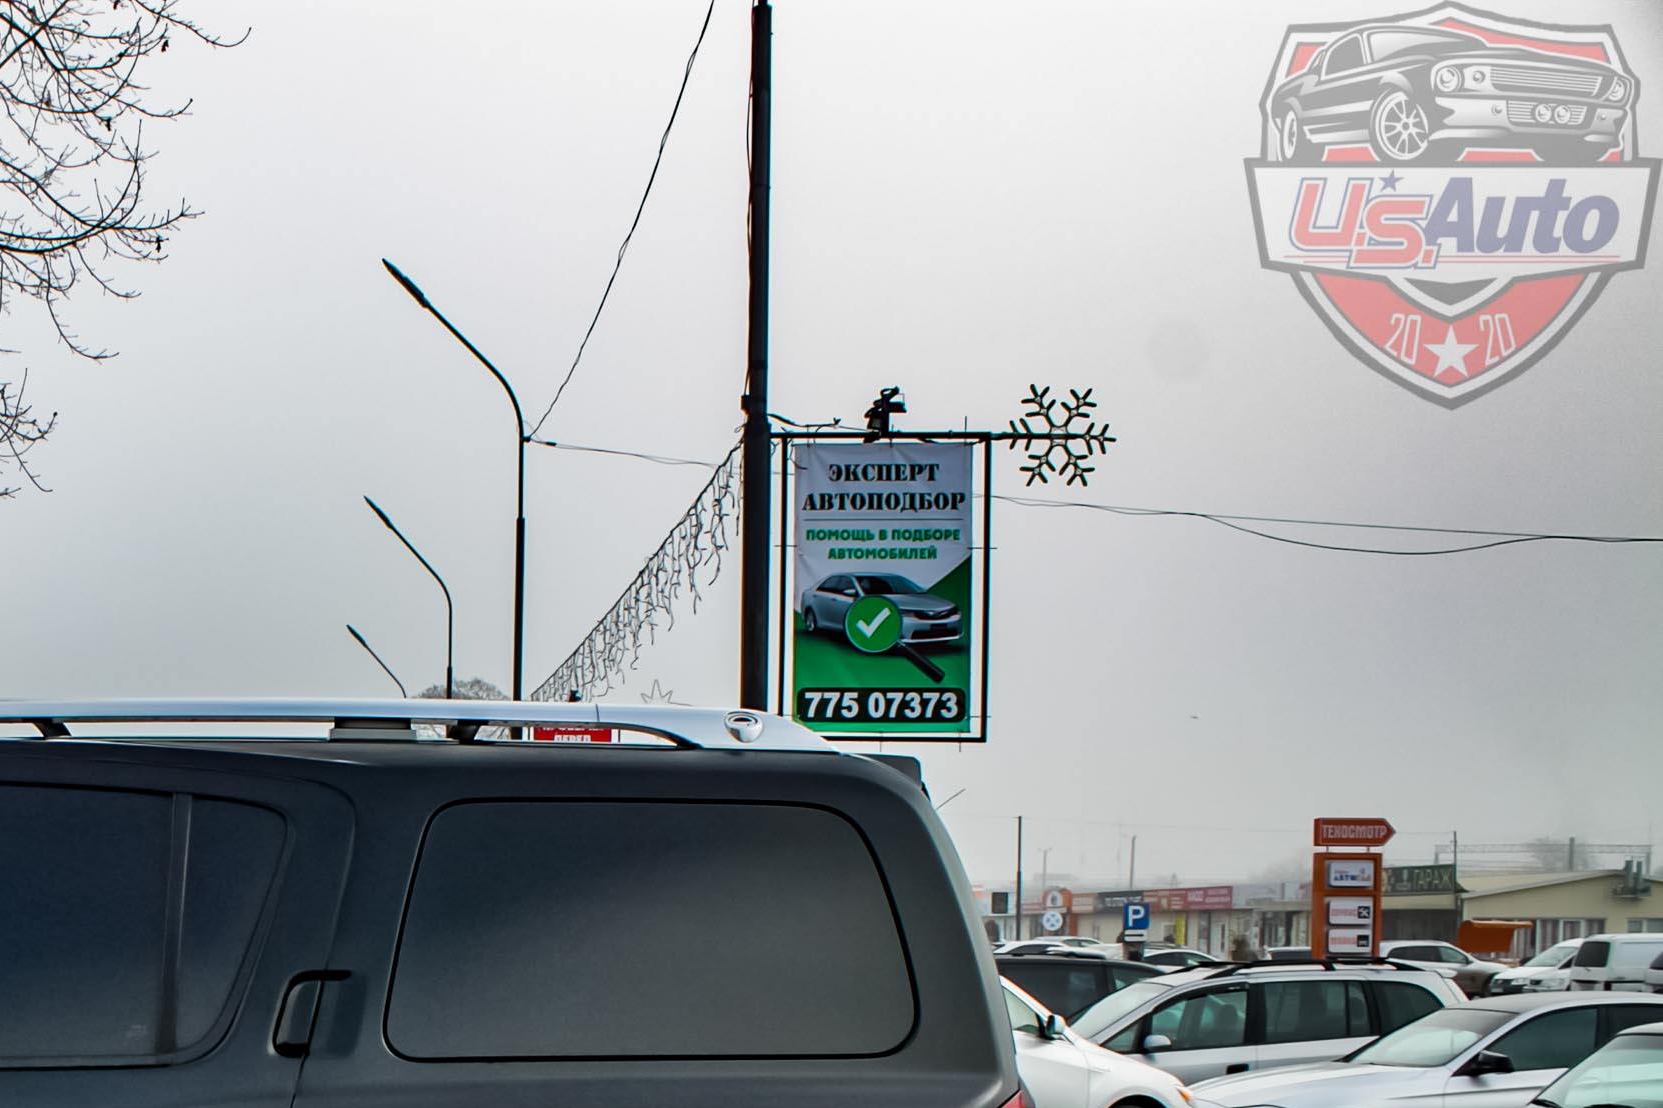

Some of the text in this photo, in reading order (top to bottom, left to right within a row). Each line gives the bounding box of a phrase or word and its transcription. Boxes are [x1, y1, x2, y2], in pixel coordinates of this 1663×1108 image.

[828, 463, 940, 482] ЭКСПЕРТ
[802, 492, 966, 512] АВТОПОДБОР
[806, 528, 961, 542] ПОМОЩЬ В ПОДБОРЕ
[827, 545, 937, 560] АВТОМОБИЛЕЙ
[804, 691, 958, 719] 775 07373
